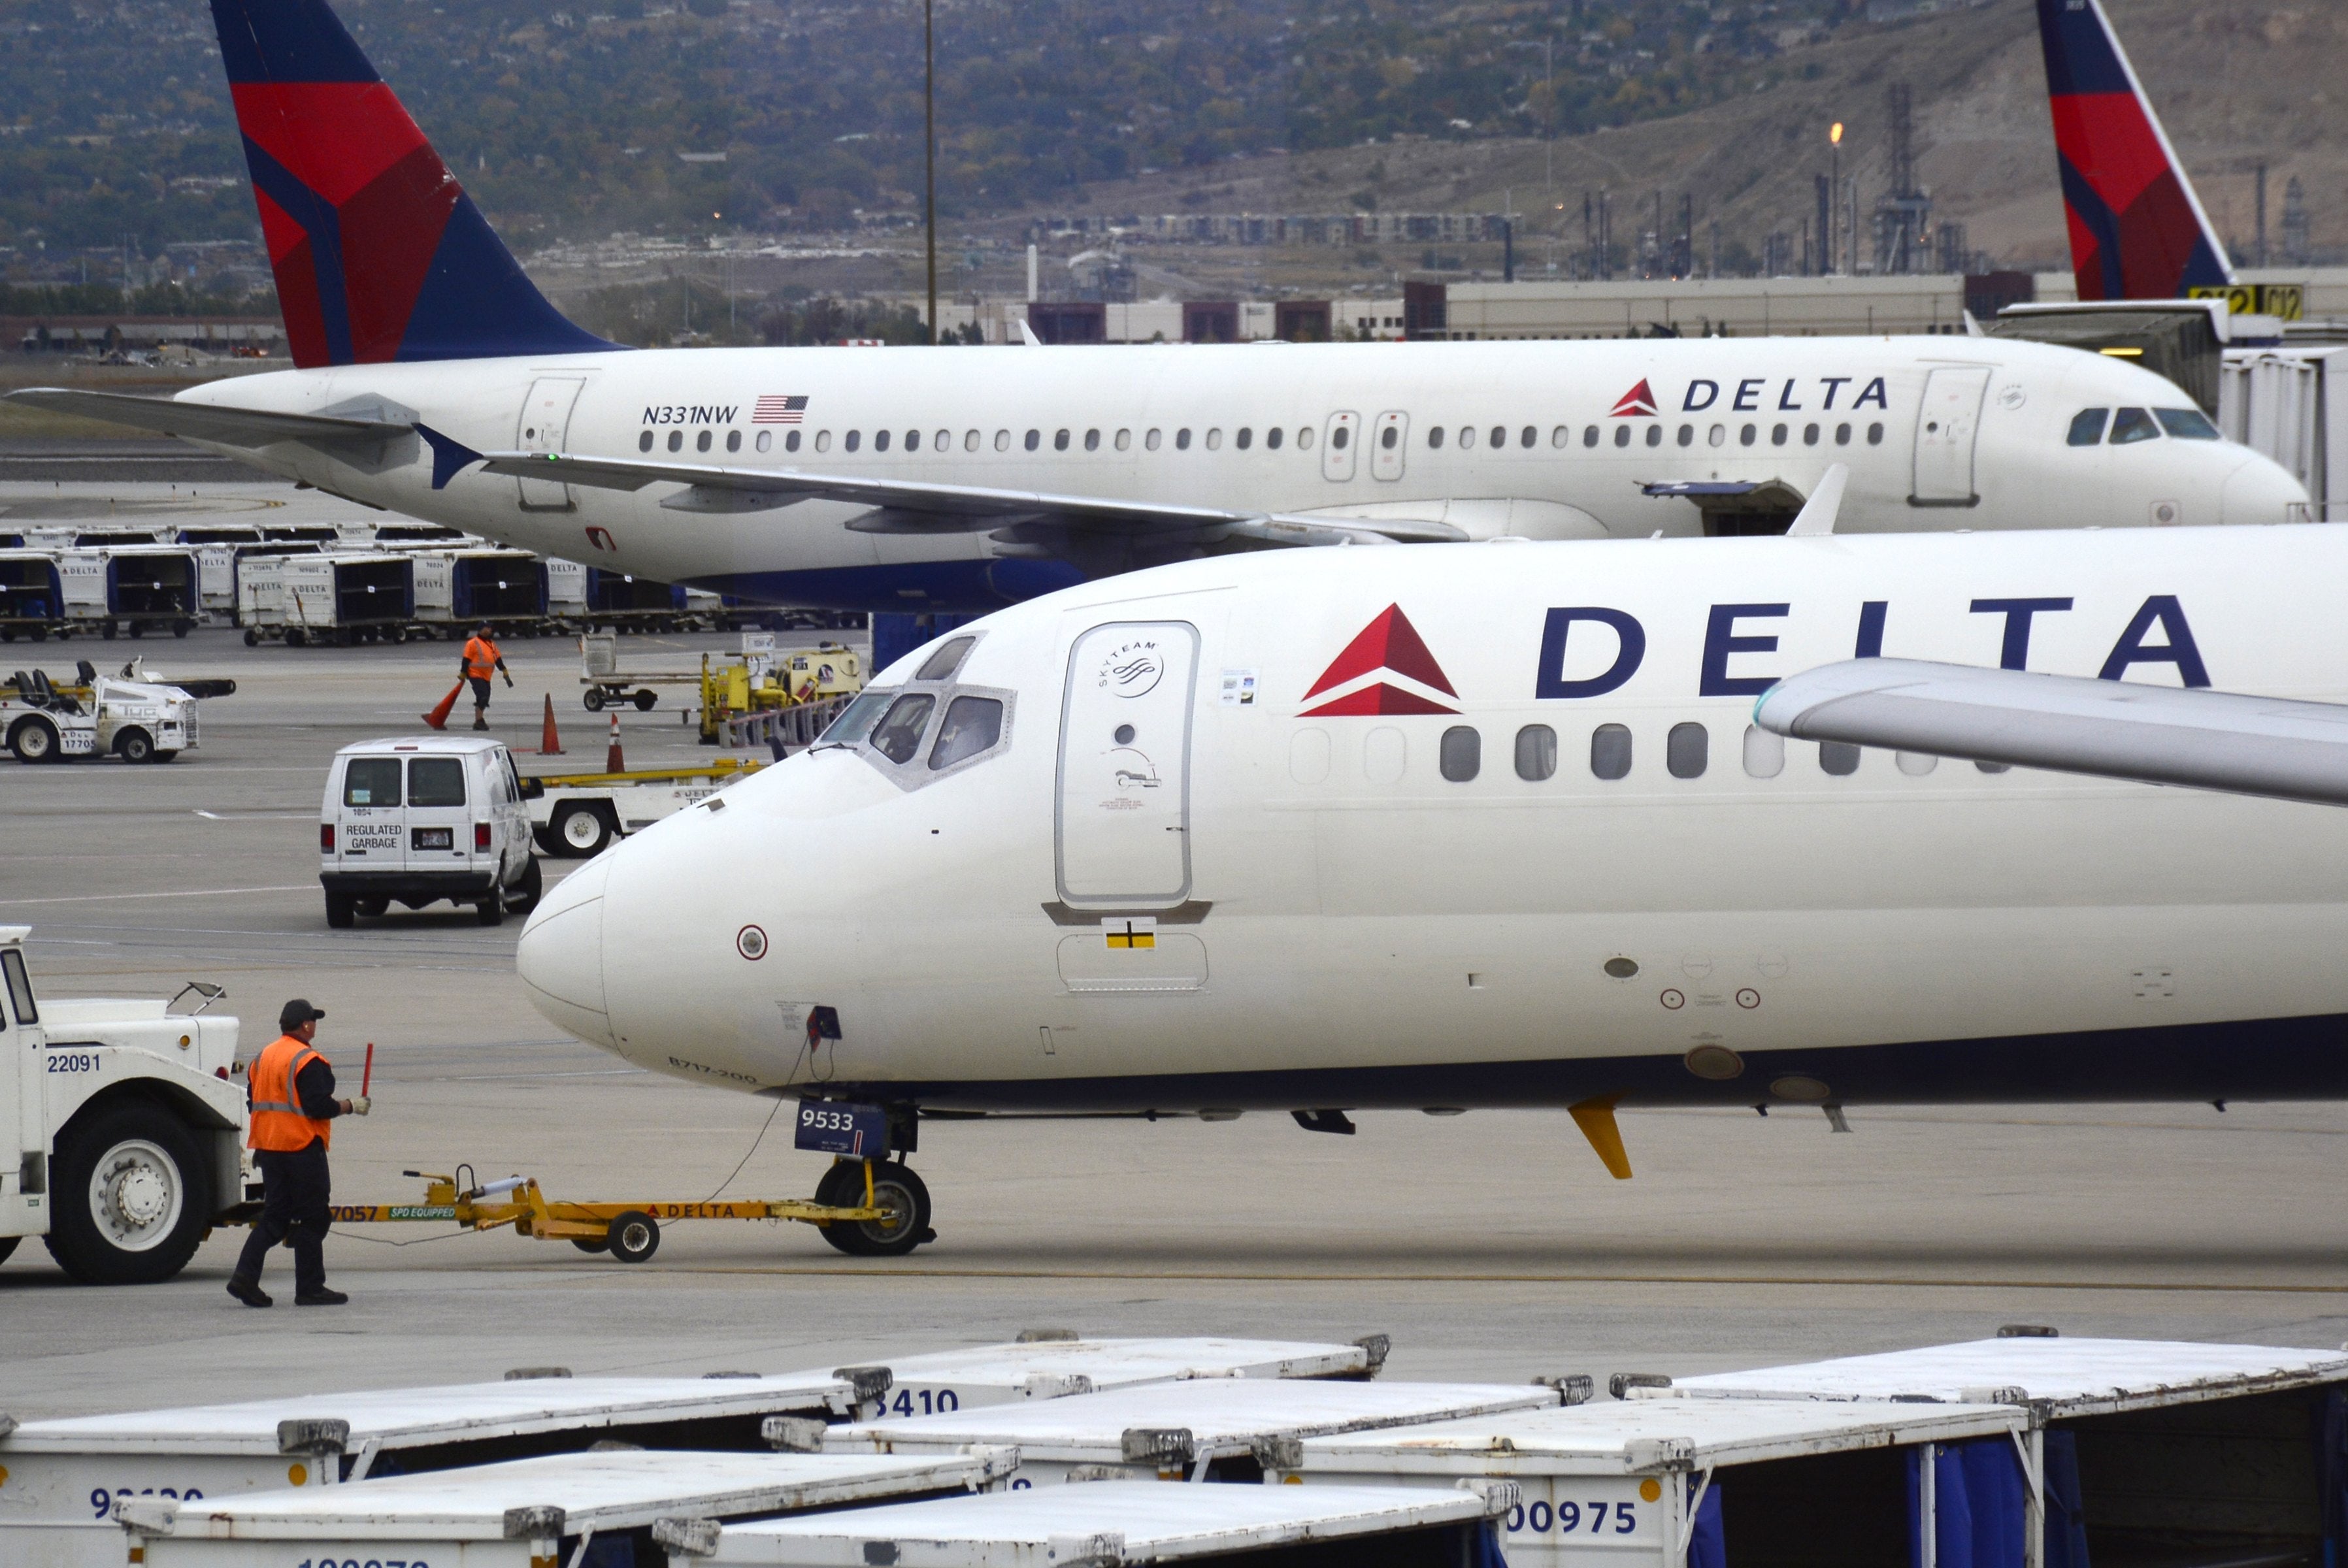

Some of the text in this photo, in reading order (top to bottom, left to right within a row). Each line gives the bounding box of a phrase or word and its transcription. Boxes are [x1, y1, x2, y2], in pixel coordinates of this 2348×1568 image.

[1682, 377, 1888, 411] DELTA
[642, 406, 738, 424] N331NW
[1099, 642, 1155, 687] SKYTEAM
[346, 825, 402, 836] REGULATED
[352, 838, 397, 849] GARBAGE
[48, 1054, 99, 1073] 22091
[669, 1056, 757, 1084] B717-200
[802, 1109, 853, 1131] 9533
[391, 1208, 455, 1218] SPD EQUIPPED
[668, 1205, 735, 1218] DELTA
[1507, 1501, 1636, 1534] 00975
